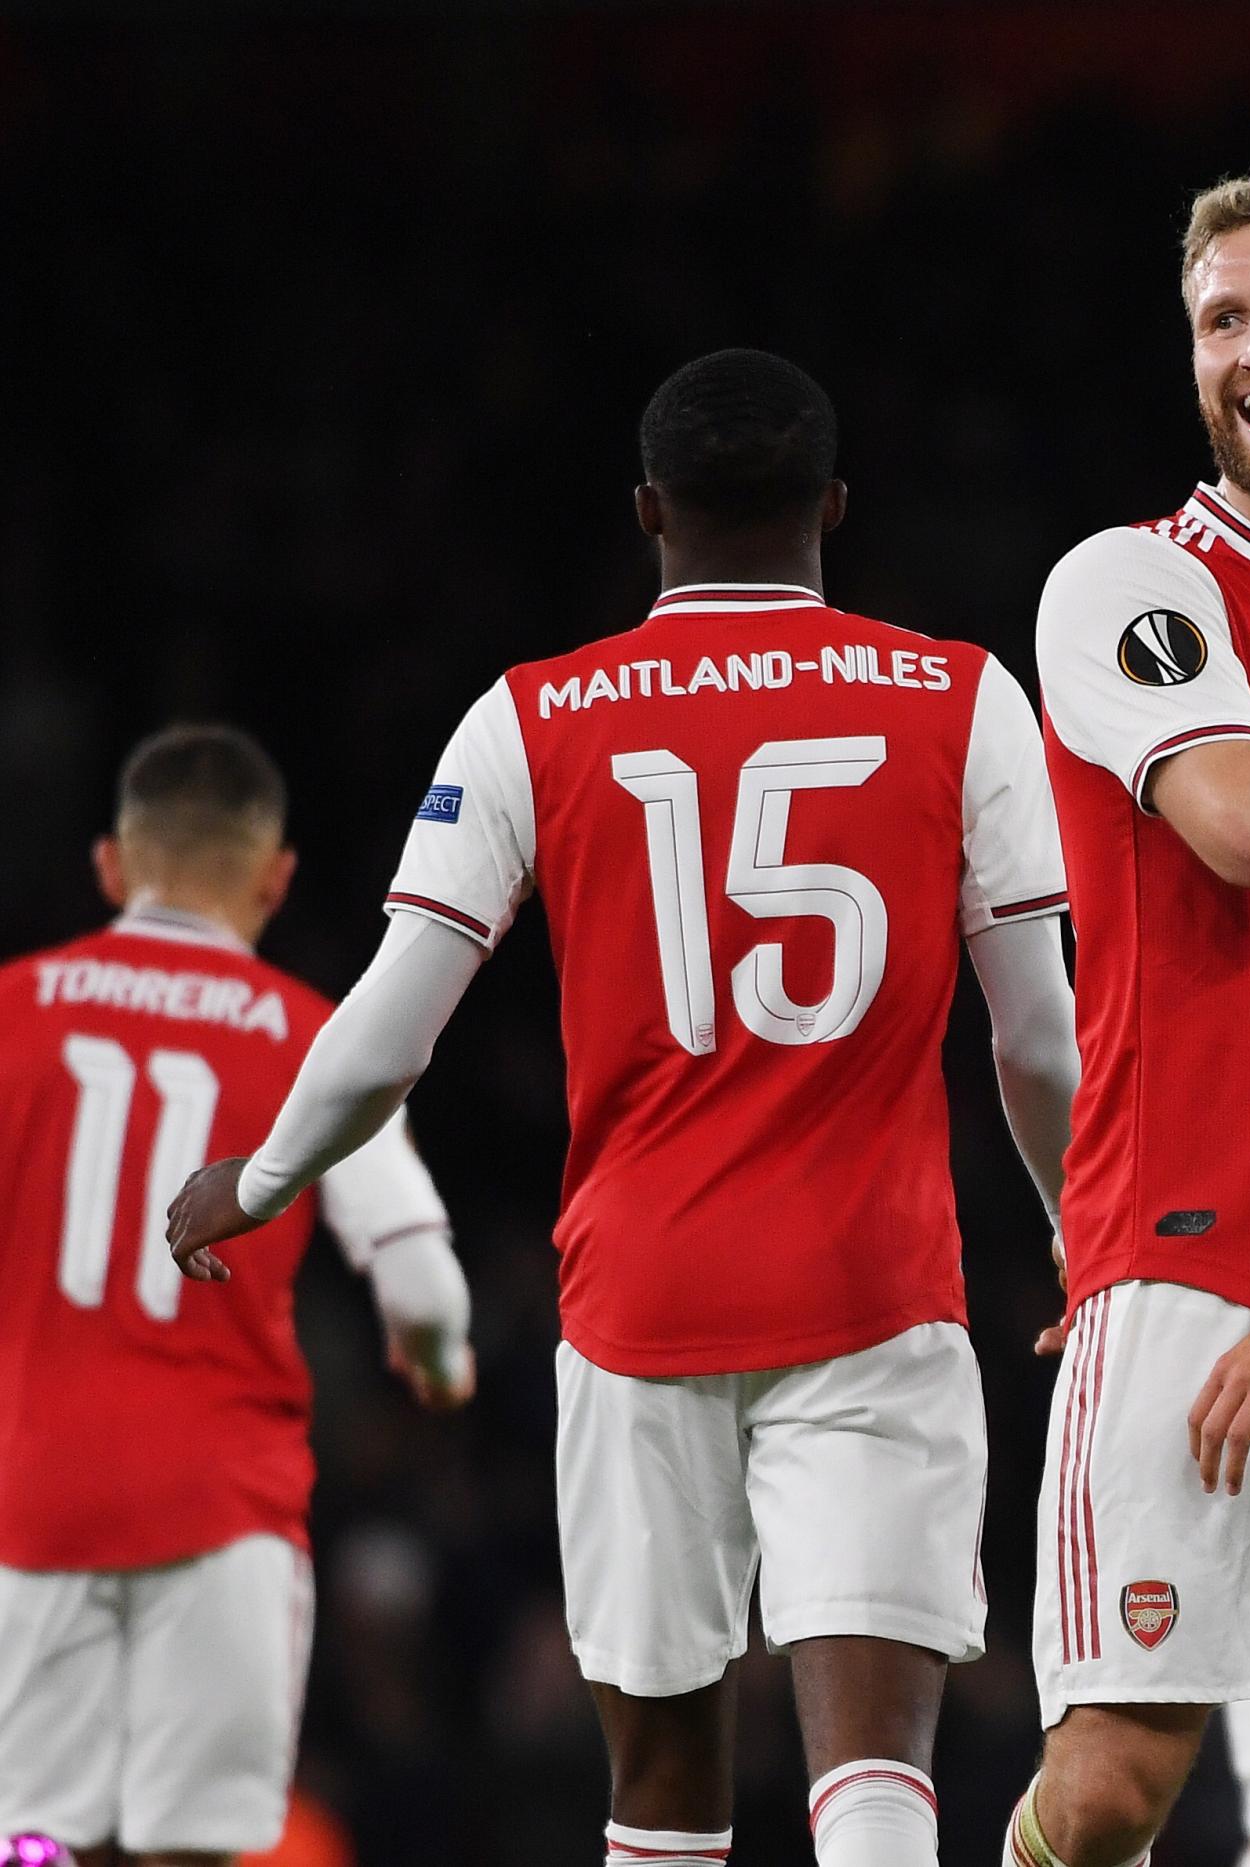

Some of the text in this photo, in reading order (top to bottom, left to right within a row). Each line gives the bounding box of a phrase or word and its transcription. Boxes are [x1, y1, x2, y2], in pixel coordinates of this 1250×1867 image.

[538, 645, 952, 720] MAITLAND-NILES
[610, 735, 889, 1057] 15
[35, 958, 290, 1042] TORREIRA
[57, 1033, 220, 1323] 11
[1128, 1591, 1171, 1603] Arsenal
